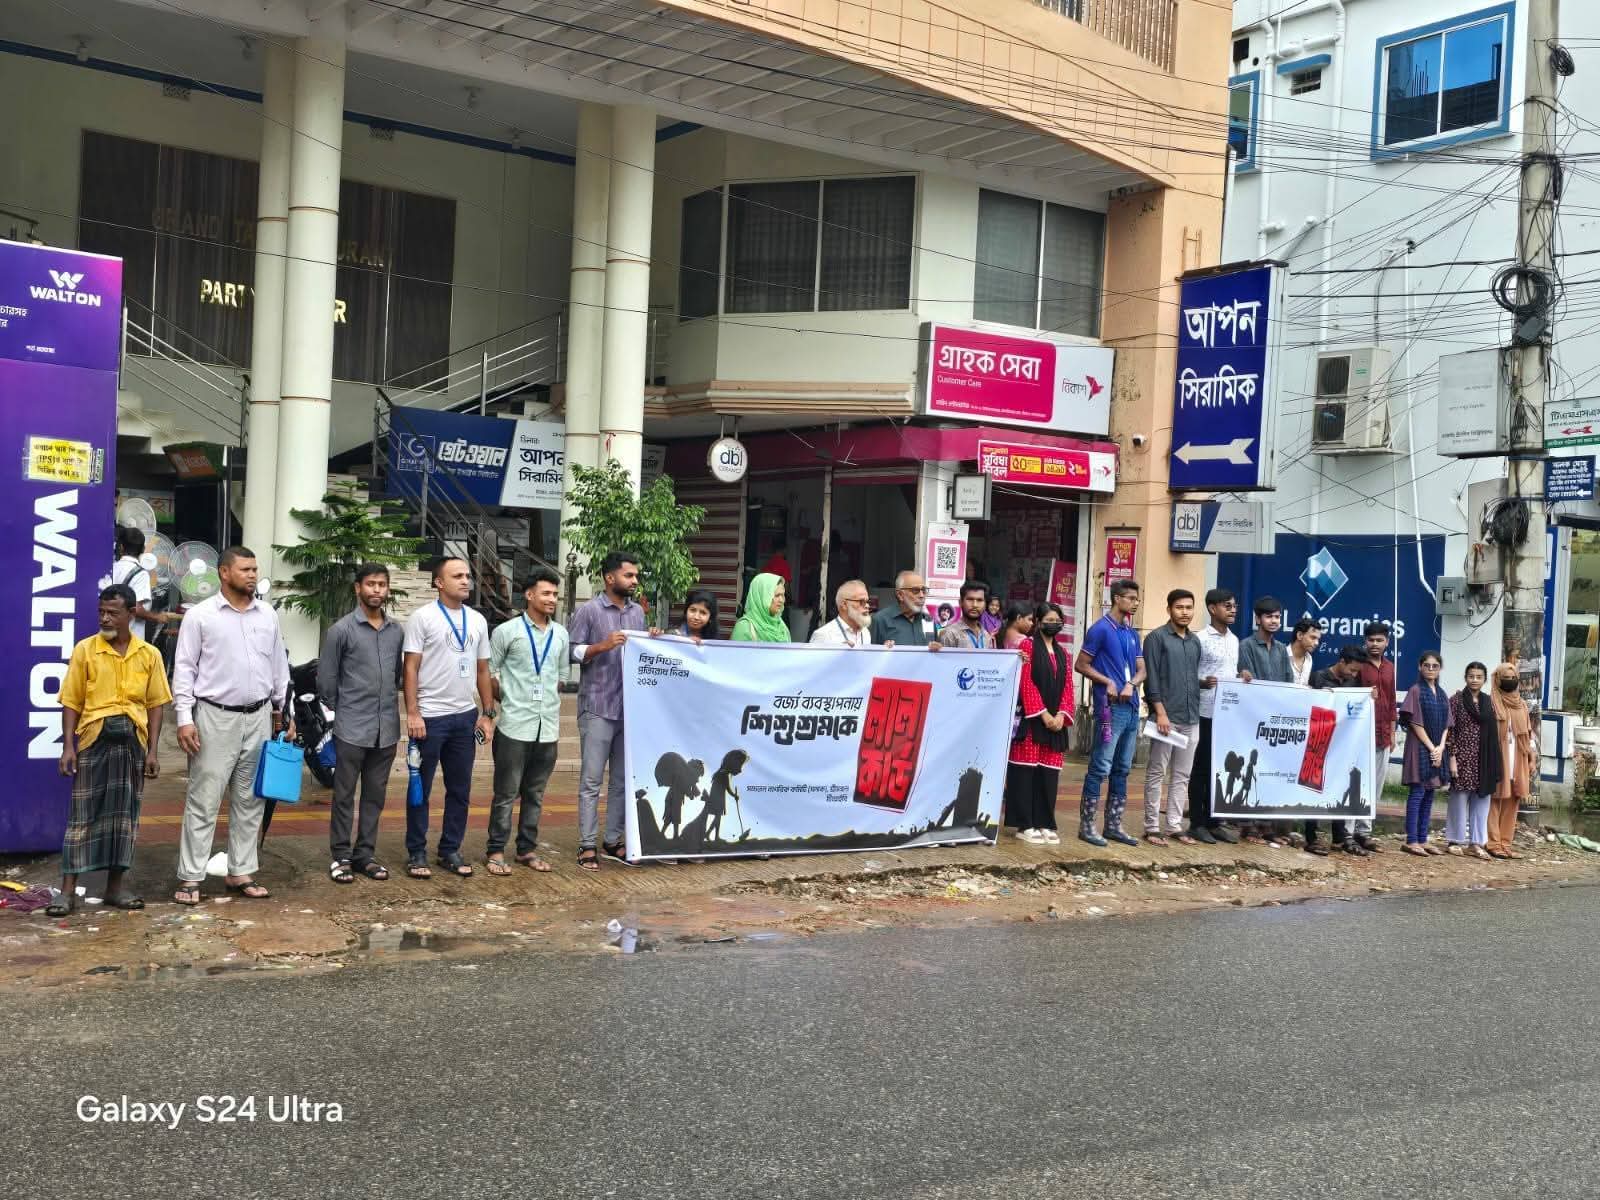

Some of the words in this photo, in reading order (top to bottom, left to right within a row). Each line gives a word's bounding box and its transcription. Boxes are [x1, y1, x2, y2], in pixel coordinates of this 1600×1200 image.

[30, 285, 101, 307] WALTON
[201, 278, 255, 309] PART
[1184, 299, 1261, 348] আপন
[938, 345, 996, 374] গ্রাহক
[1000, 353, 1042, 381] সেবা
[937, 375, 967, 386] Customer
[968, 379, 982, 388] Care
[1179, 364, 1259, 409] সিরামিক
[720, 449, 743, 467] dbl
[1177, 513, 1199, 530] dbl
[27, 488, 79, 760] WALTON
[1302, 611, 1405, 639] erams
[773, 690, 802, 709] বর্জ্য
[801, 696, 864, 712] ব্যবস্থাপনায়
[740, 704, 859, 746] শিশুশ্রমকে
[863, 686, 925, 752] লাল
[857, 742, 914, 803] কার্ড
